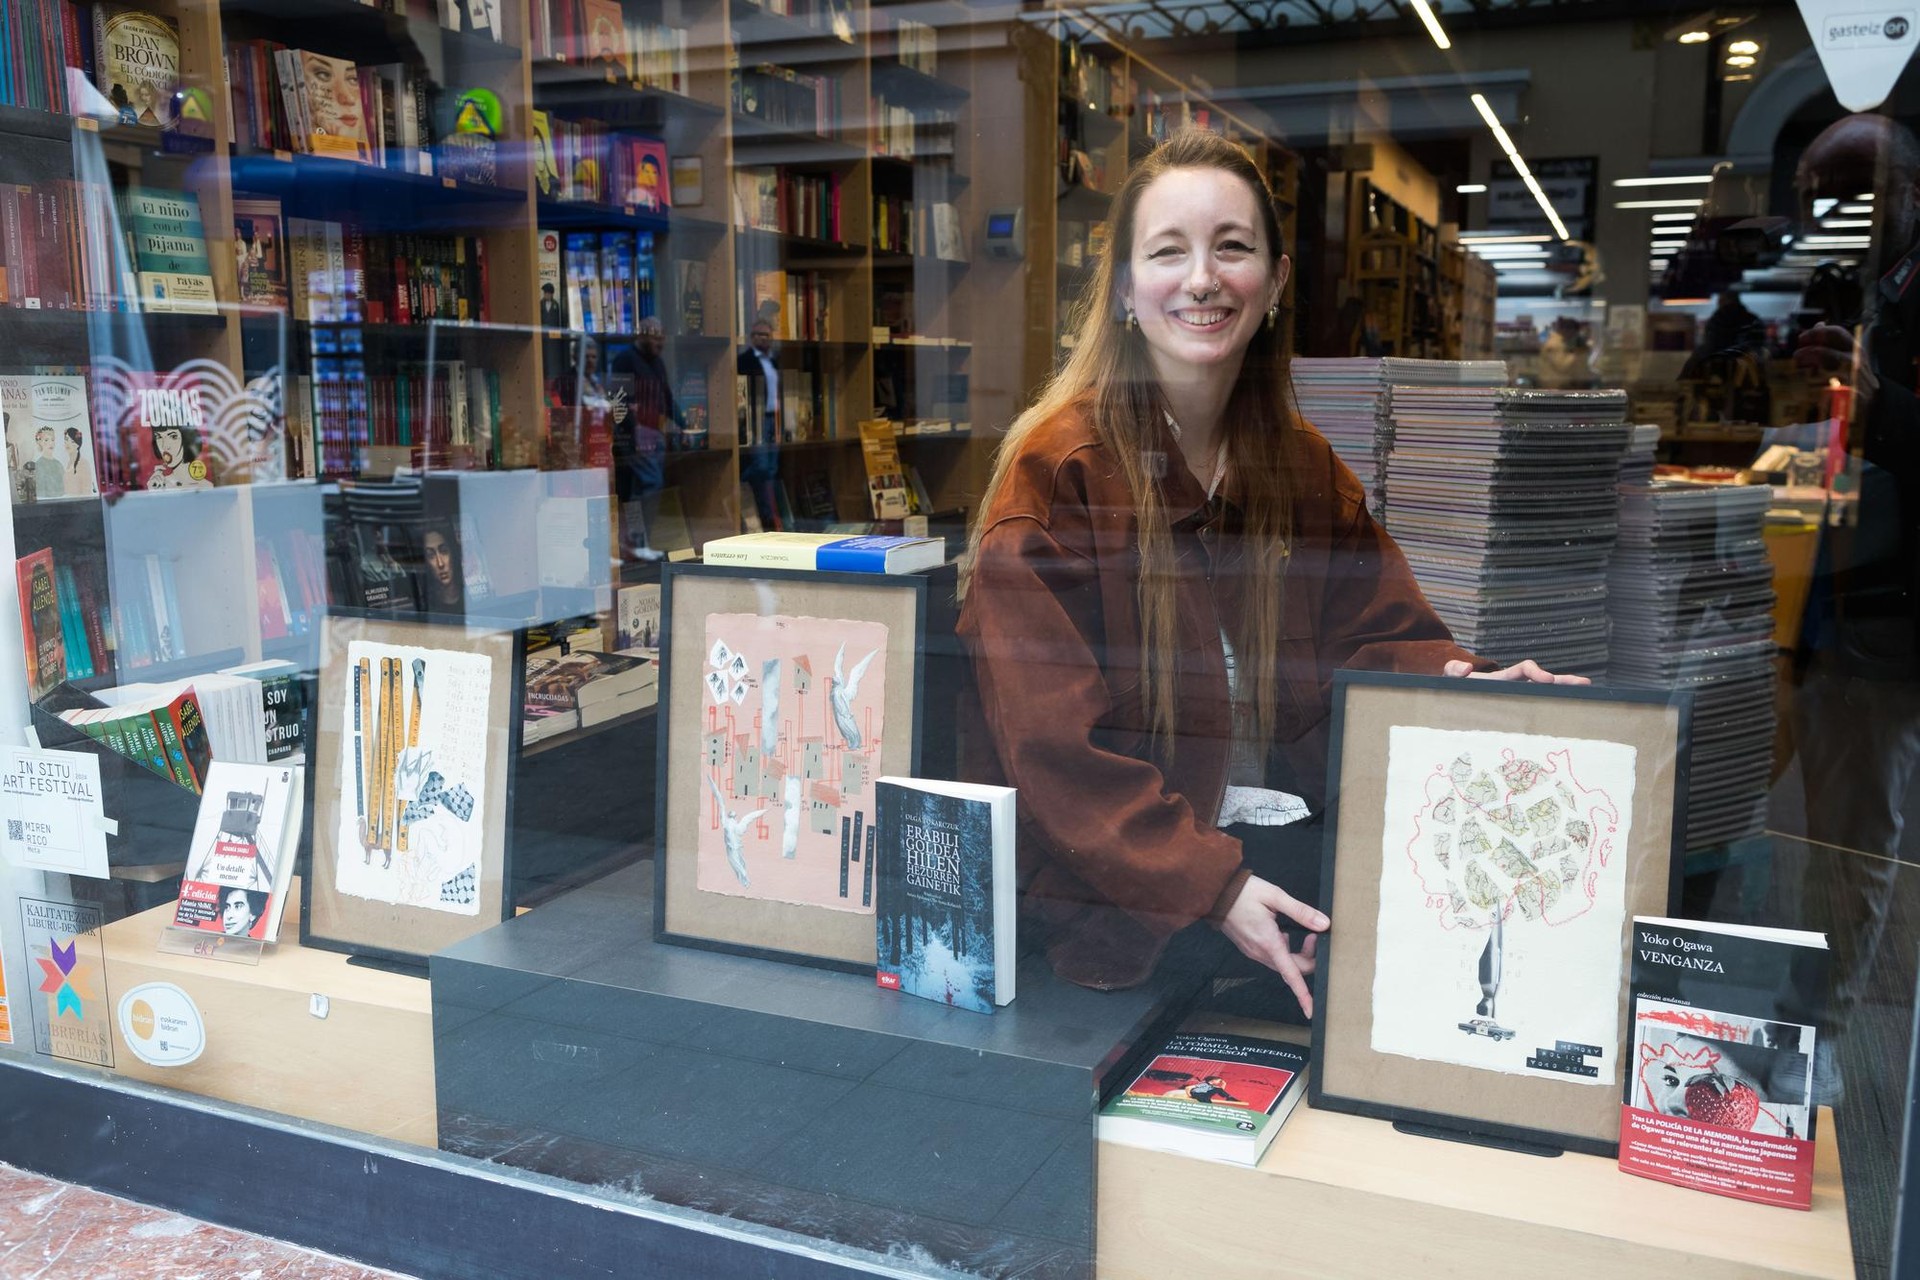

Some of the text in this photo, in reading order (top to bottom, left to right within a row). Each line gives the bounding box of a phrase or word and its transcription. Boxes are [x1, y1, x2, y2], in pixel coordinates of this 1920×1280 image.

[1829, 22, 1881, 41] gasteiz
[131, 33, 160, 51] DAN
[114, 44, 176, 71] BROWN
[120, 64, 133, 75] EL
[142, 202, 190, 218] El niño
[153, 222, 183, 233] con el
[147, 236, 195, 253] pijama
[168, 261, 180, 271] de
[176, 277, 205, 289] rayas
[354, 269, 366, 299] NUNCA
[0, 379, 18, 389] ONIO
[1, 388, 27, 401] ANAS
[138, 389, 203, 428] ZORRAS
[736, 553, 748, 562] Los
[33, 577, 50, 594] ISABEL
[33, 590, 54, 611] ALLENDE
[267, 689, 287, 705] SOY
[528, 692, 569, 702] ENCRUCIJADAS
[178, 700, 195, 722] ISABEL
[159, 722, 172, 745] ALLENDE
[166, 723, 176, 742] ISABEL
[181, 712, 201, 738] ALLENDE
[265, 723, 299, 742] STRUO
[125, 731, 136, 755] ALLENDE
[132, 732, 142, 751] ISABEL
[141, 727, 153, 751] ALLENDE
[149, 728, 157, 747] ISABEL
[268, 744, 292, 756] CHAPARRO
[19, 760, 70, 779] IN SITU
[3, 775, 93, 797] ART FESTIVAL
[25, 822, 51, 834] MIREN
[905, 814, 922, 823] OLGA
[27, 834, 48, 846] RICO
[906, 824, 959, 848] ERABILI
[906, 837, 960, 860] GOLDEA
[225, 864, 245, 873] detalle
[906, 848, 960, 876] HILEN
[906, 863, 960, 885] HEZURREN
[907, 873, 961, 896] GAINETIK
[191, 889, 217, 901] edición
[27, 904, 96, 924] KALITATEZKO
[28, 918, 96, 937] LIBURU-DENDAK
[1640, 931, 1714, 953] Yoko Ogawa
[1640, 950, 1725, 974] VENGANZA
[40, 1022, 107, 1046] LIBRERÍAS
[42, 1041, 108, 1063] de CALIDAD
[1189, 1046, 1248, 1057] PROFESOR
[1242, 1046, 1303, 1061] PREFERIDA
[1560, 1044, 1600, 1054] MEMORY
[1631, 1113, 1645, 1122] Tras
[1645, 1117, 1655, 1125] LA
[1655, 1119, 1682, 1131] POLICÍA
[1683, 1125, 1692, 1133] DE
[1703, 1129, 1742, 1143] MEMORIA,
[1742, 1136, 1750, 1144] la
[1750, 1139, 1798, 1153] confirmación
[1641, 1124, 1665, 1134] Ogawa
[1665, 1131, 1685, 1139] como
[1686, 1133, 1699, 1142] una
[1700, 1136, 1709, 1144] de
[1710, 1139, 1720, 1147] las
[1720, 1142, 1759, 1154] narradoras
[1760, 1148, 1797, 1160] japonesas
[1661, 1137, 1763, 1163] más relevantes del momento.
